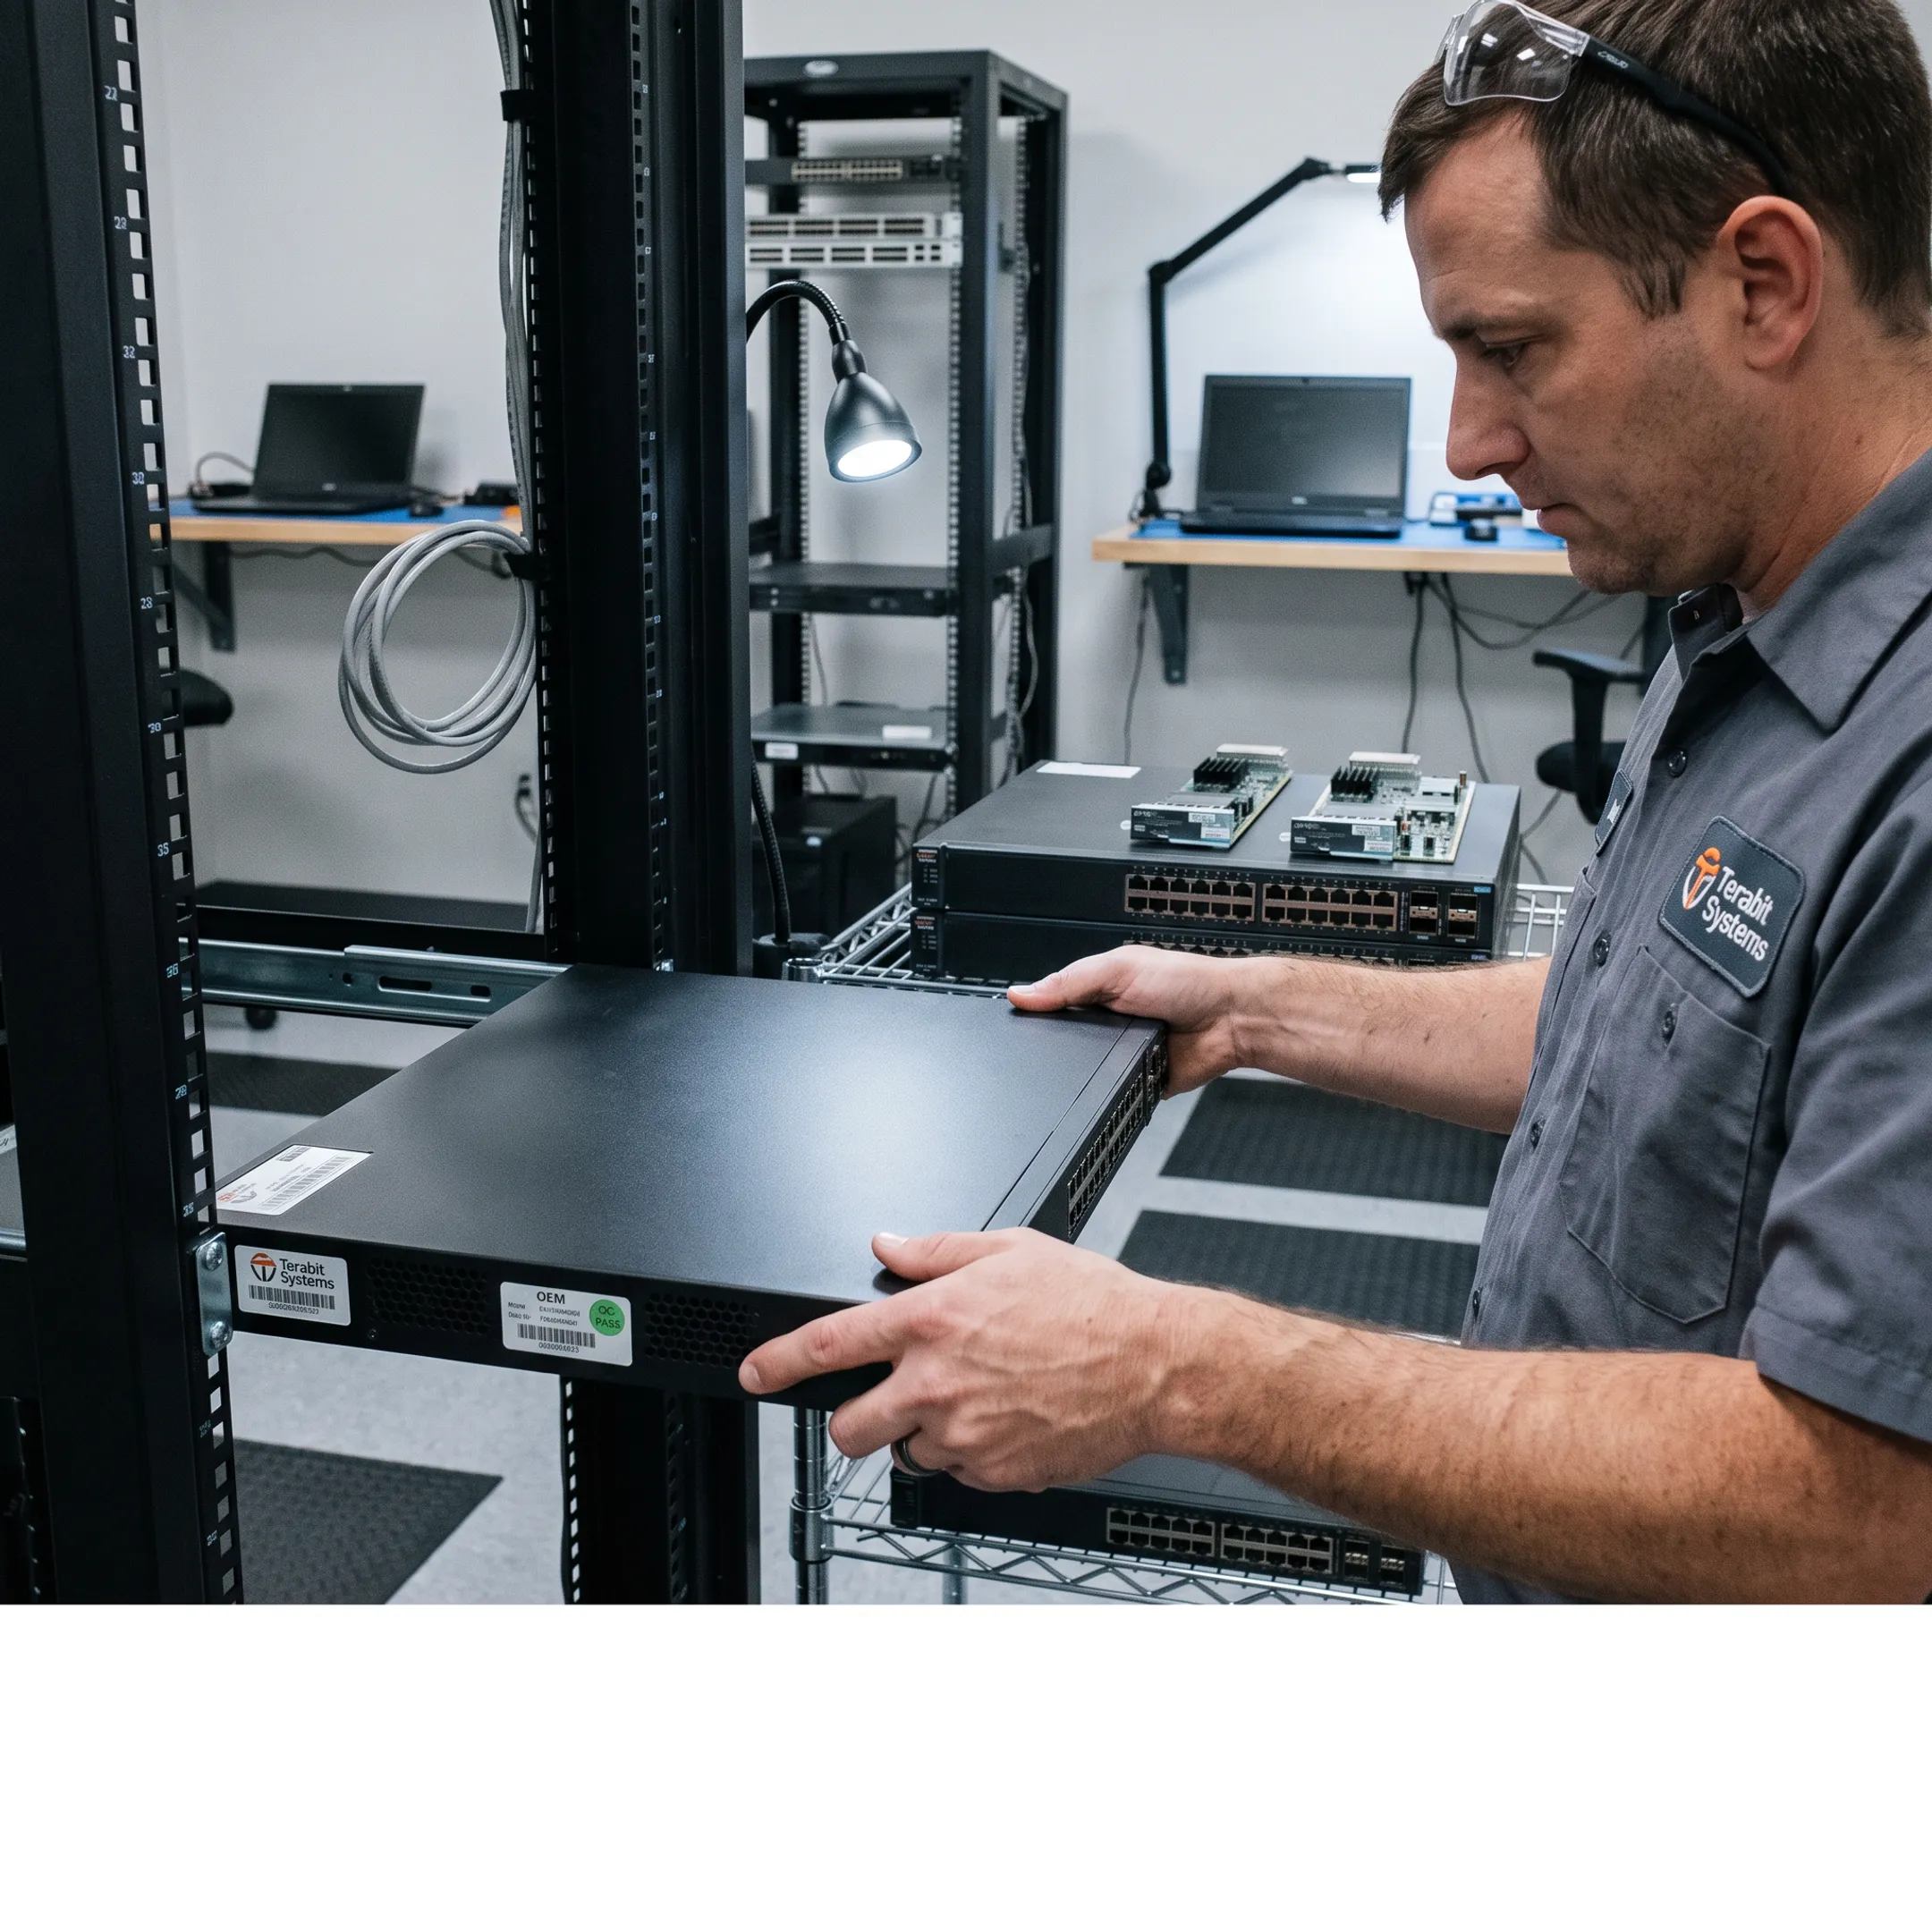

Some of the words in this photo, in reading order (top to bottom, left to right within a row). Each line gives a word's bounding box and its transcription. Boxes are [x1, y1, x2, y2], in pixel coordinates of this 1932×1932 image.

[1716, 866, 1774, 926] Terabit
[1702, 895, 1768, 962] Systems
[279, 1258, 326, 1276] Terabit
[280, 1271, 335, 1290] Systems
[537, 1291, 565, 1305] OEM
[596, 1318, 621, 1329] PASS
